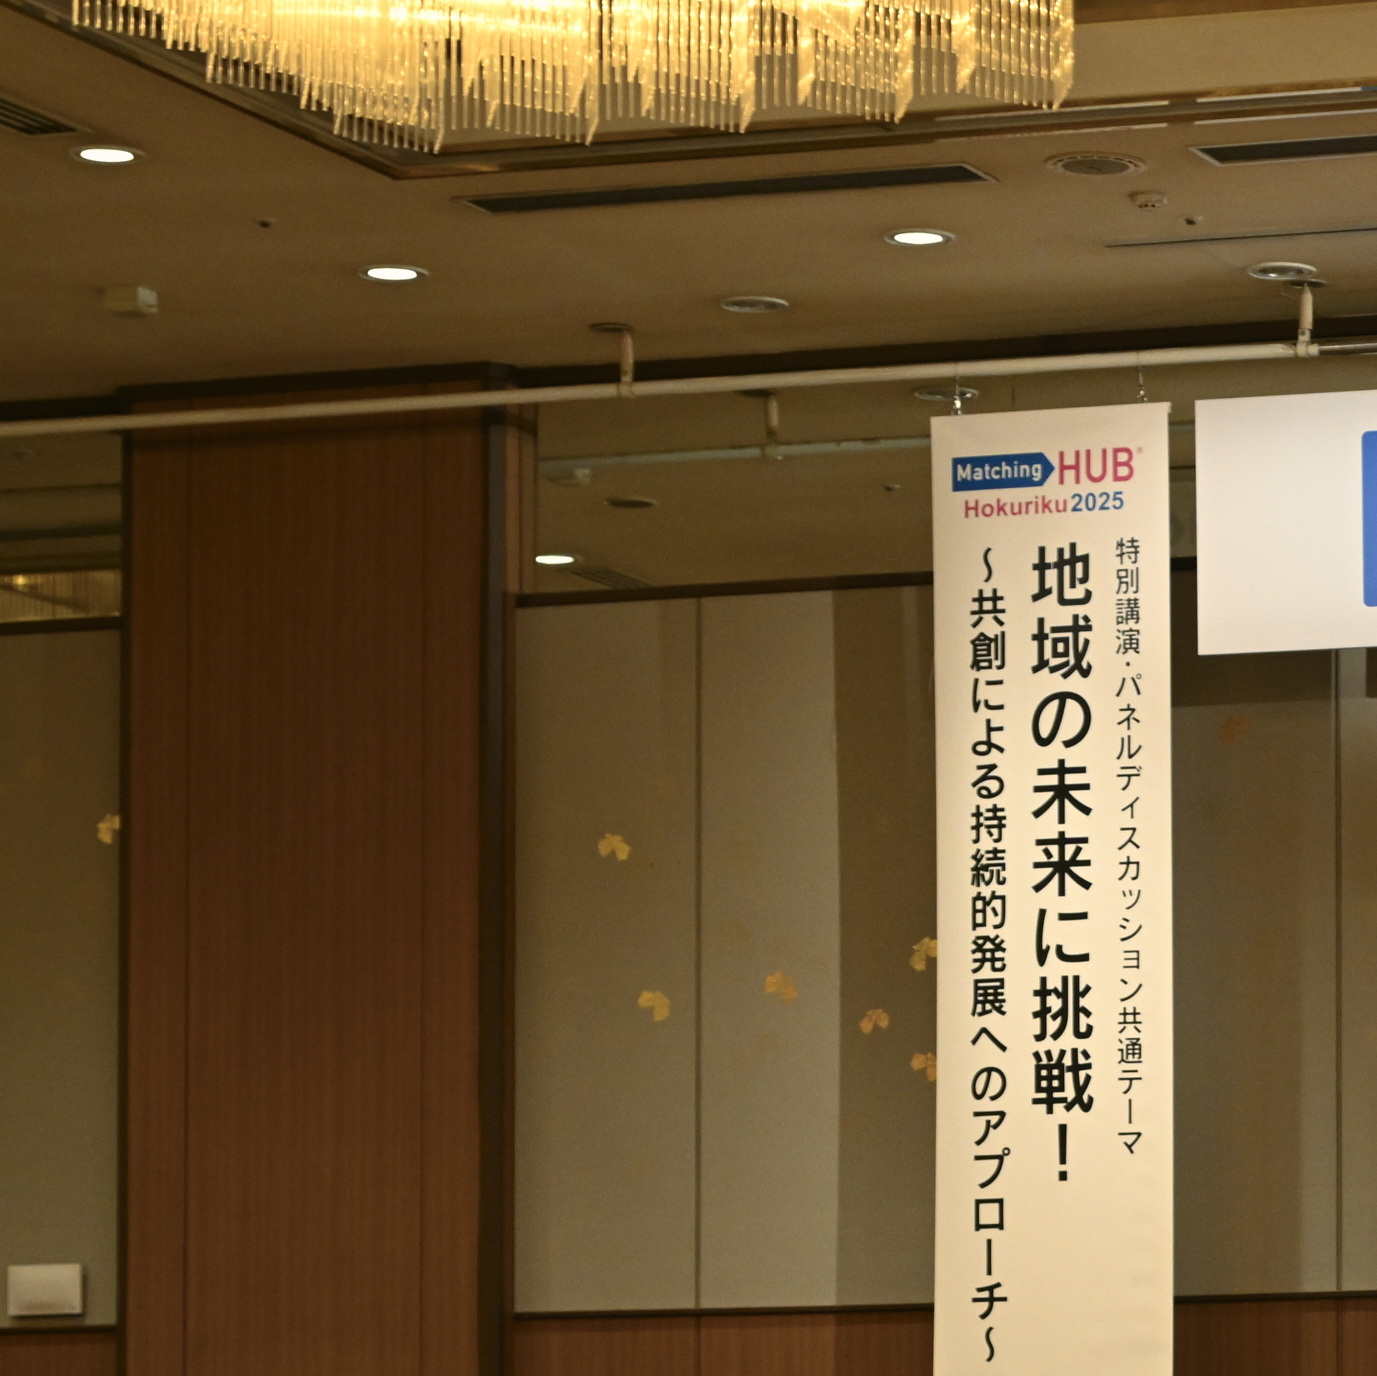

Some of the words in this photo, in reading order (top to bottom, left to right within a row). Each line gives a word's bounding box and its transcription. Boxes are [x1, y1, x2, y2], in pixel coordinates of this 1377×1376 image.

[956, 461, 1043, 482] Matching
[1058, 447, 1134, 485] HUB
[964, 495, 1068, 518] Hokuriku
[1071, 491, 1124, 512] 2025
[1031, 542, 1093, 1182] 地域の未来に挑戦！
[1115, 537, 1143, 1155] 特別講演・パネルディスカッション共通テーマ
